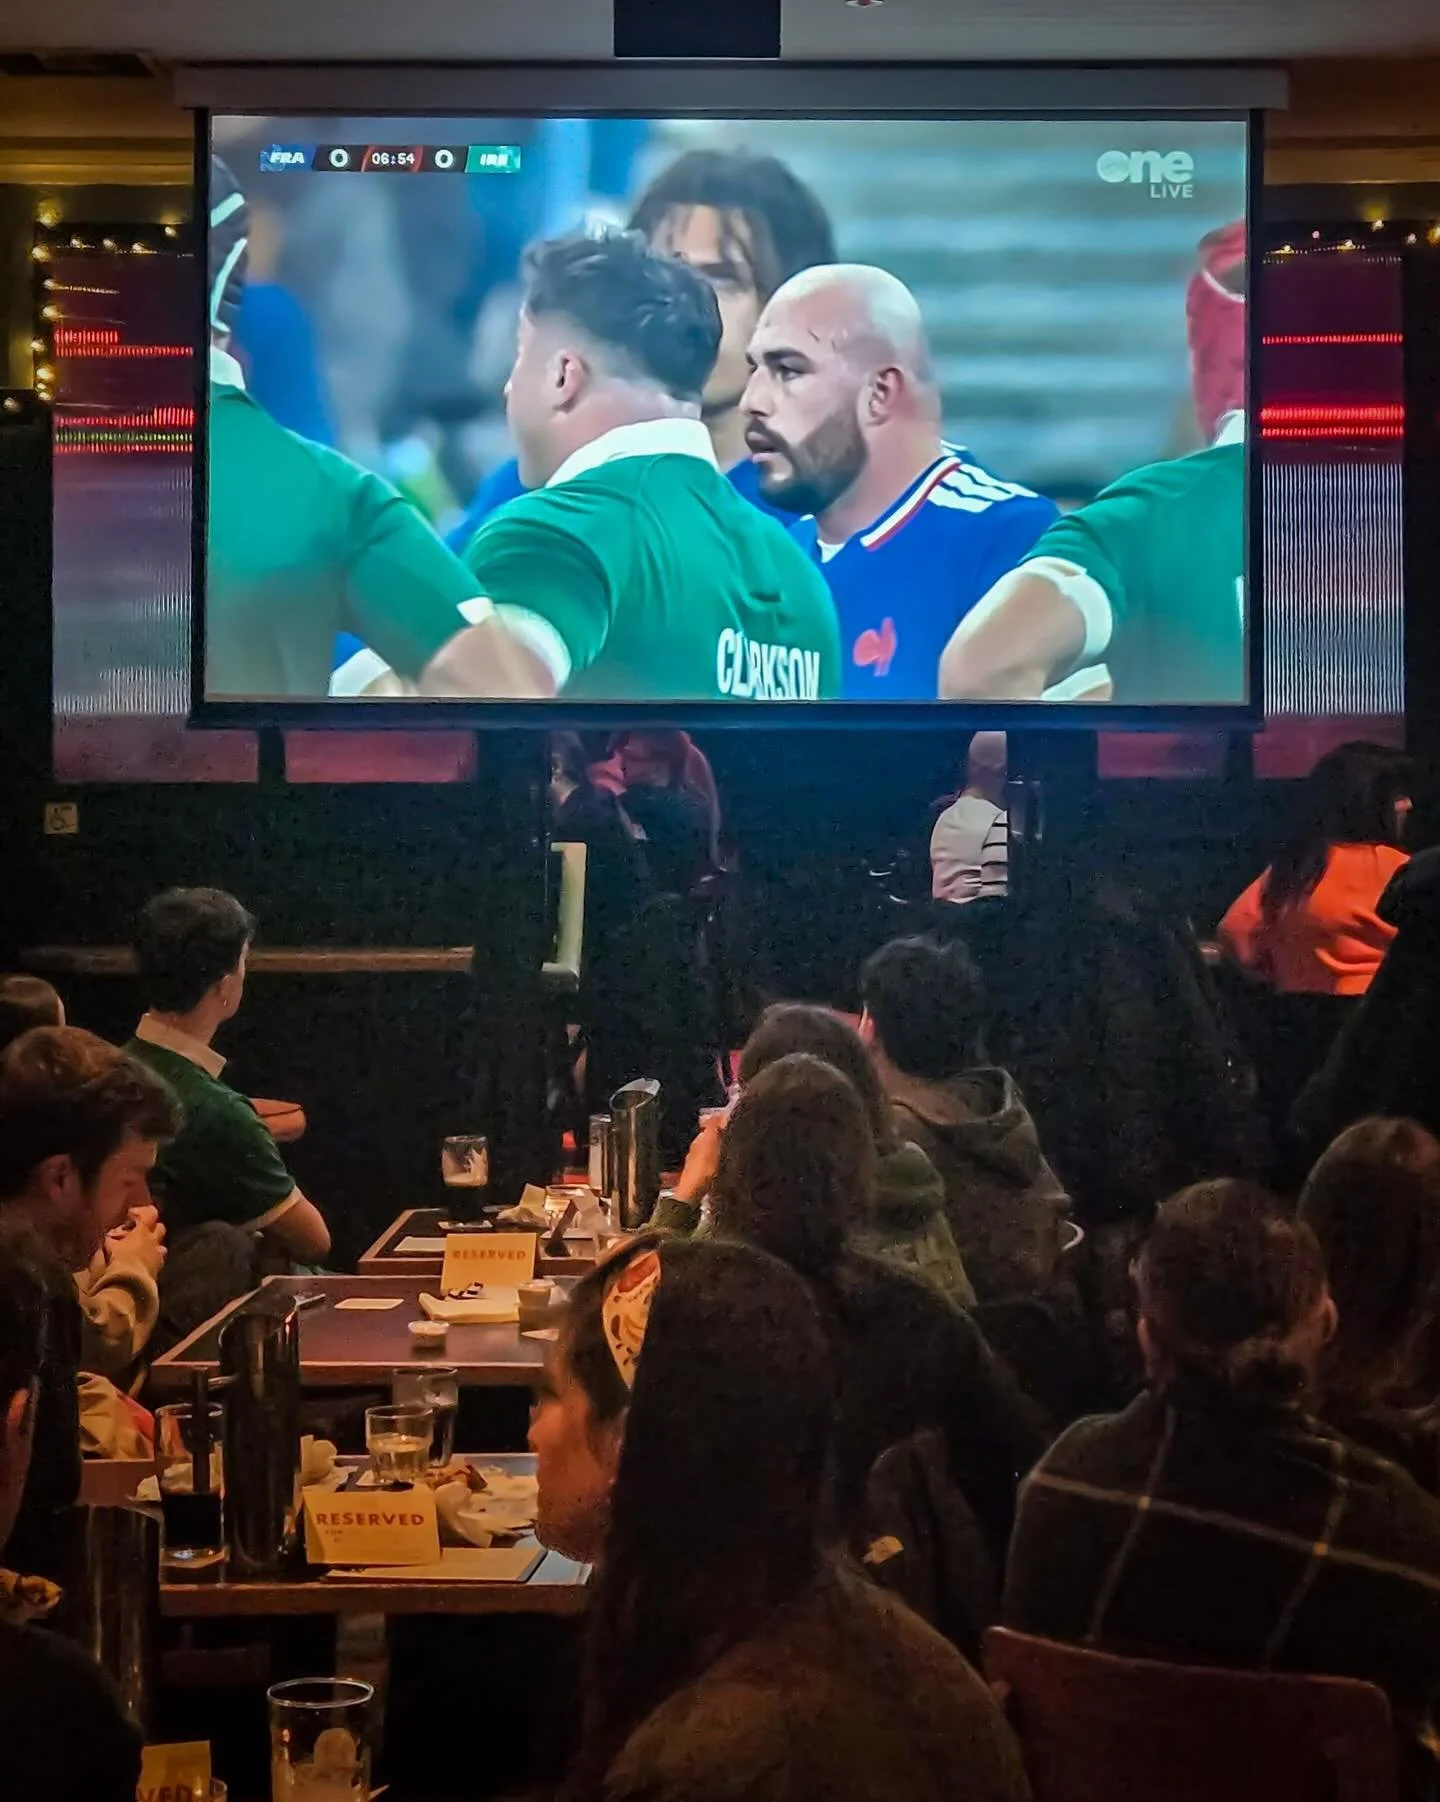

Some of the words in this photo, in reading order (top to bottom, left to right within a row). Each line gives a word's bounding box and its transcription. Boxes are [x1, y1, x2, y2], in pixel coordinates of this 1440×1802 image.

[270, 151, 305, 164] FRA
[371, 152, 415, 166] 06:54
[1096, 150, 1195, 184] one
[1150, 184, 1193, 199] LIVE
[452, 1249, 526, 1261] RESERVED
[316, 1512, 424, 1526] RESERVED
